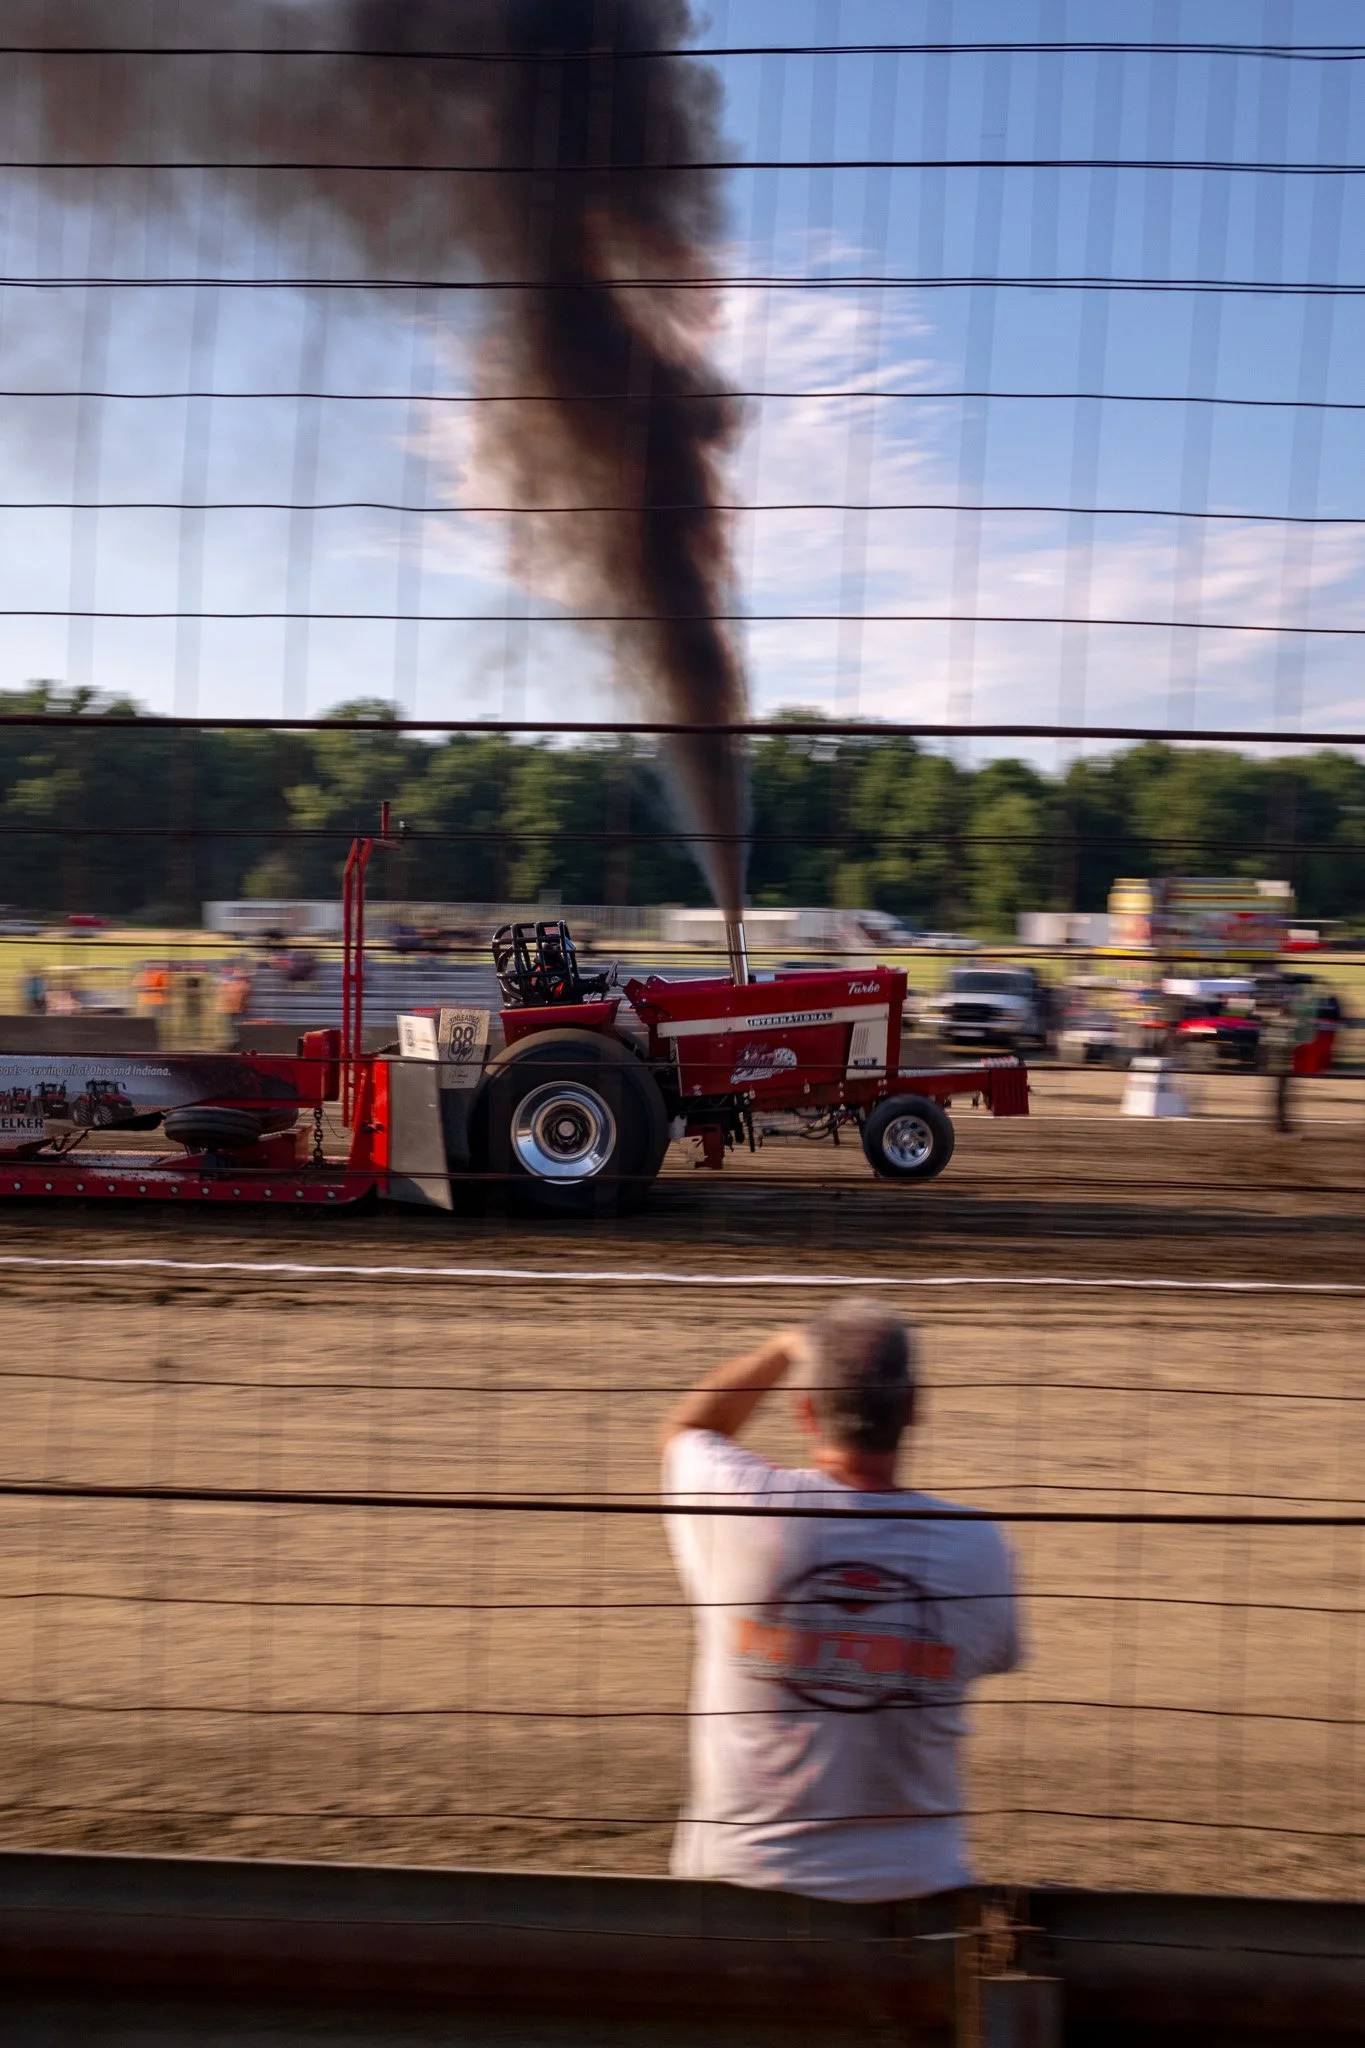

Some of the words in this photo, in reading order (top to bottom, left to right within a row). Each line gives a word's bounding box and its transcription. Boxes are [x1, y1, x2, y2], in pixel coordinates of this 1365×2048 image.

[847, 980, 880, 994] Turbo
[450, 1014, 480, 1025] UNLEADED
[748, 1013, 833, 1026] INTERNATIONAL
[451, 1026, 474, 1055] 88
[28, 1066, 62, 1077] serving
[64, 1064, 77, 1075] all
[78, 1065, 89, 1075] of
[90, 1065, 111, 1075] Ohio
[113, 1065, 131, 1075] and
[132, 1065, 171, 1076] Indiana.
